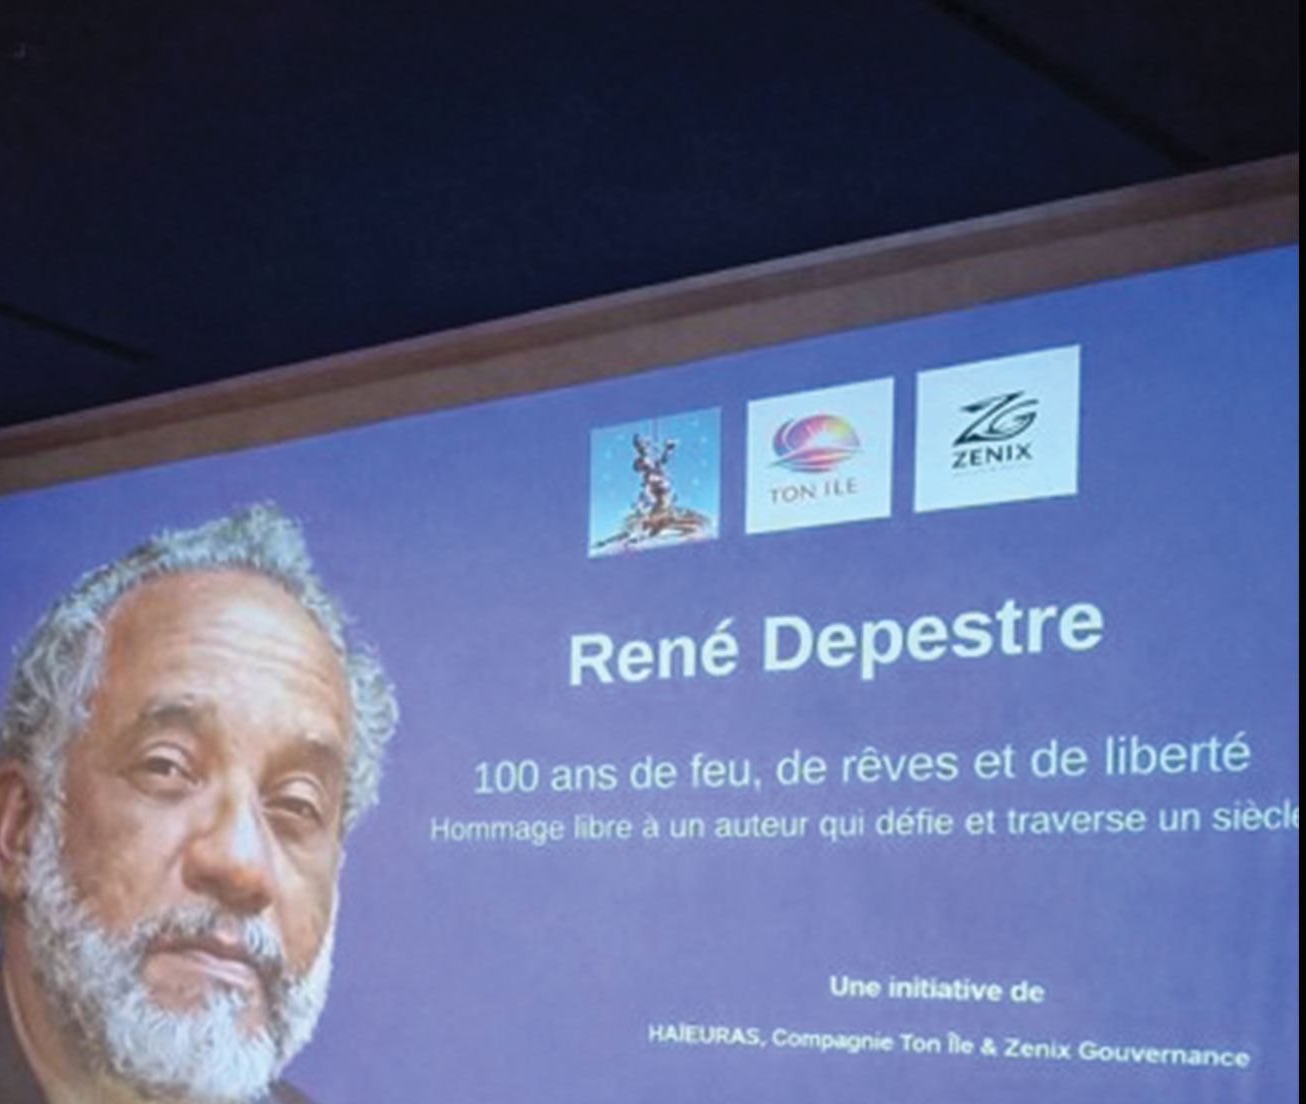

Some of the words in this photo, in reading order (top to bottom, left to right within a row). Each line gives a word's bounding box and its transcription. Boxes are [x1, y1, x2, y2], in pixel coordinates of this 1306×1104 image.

[952, 443, 1033, 469] ZENIX
[770, 484, 816, 504] TON
[570, 619, 739, 686] René
[763, 599, 1104, 680] Depestre
[474, 760, 539, 794] 100
[551, 763, 617, 791] ans
[630, 755, 677, 790] de
[691, 751, 763, 790] feu,
[776, 749, 828, 786] de
[842, 741, 960, 785] rêves
[974, 744, 1017, 781] et
[1031, 739, 1089, 777] de
[1105, 730, 1253, 775] liberté
[431, 815, 565, 845] Hommage
[574, 811, 633, 840] libre
[642, 812, 660, 840] à
[669, 814, 705, 840] un
[714, 812, 807, 840] auteur
[819, 806, 865, 846] qui
[875, 804, 954, 838] défie
[965, 808, 997, 836] et
[1007, 806, 1147, 832] traverse
[1158, 806, 1202, 831] un
[830, 974, 881, 999] Une
[889, 976, 1002, 1001] initiative
[1010, 980, 1045, 1003] de
[772, 1028, 894, 1053] Compagnie
[900, 1032, 942, 1055] Ton
[948, 1030, 974, 1055] Île
[980, 1037, 997, 1056] &
[1004, 1038, 1071, 1060] Zenix
[1078, 1041, 1251, 1067] Gouvernance
